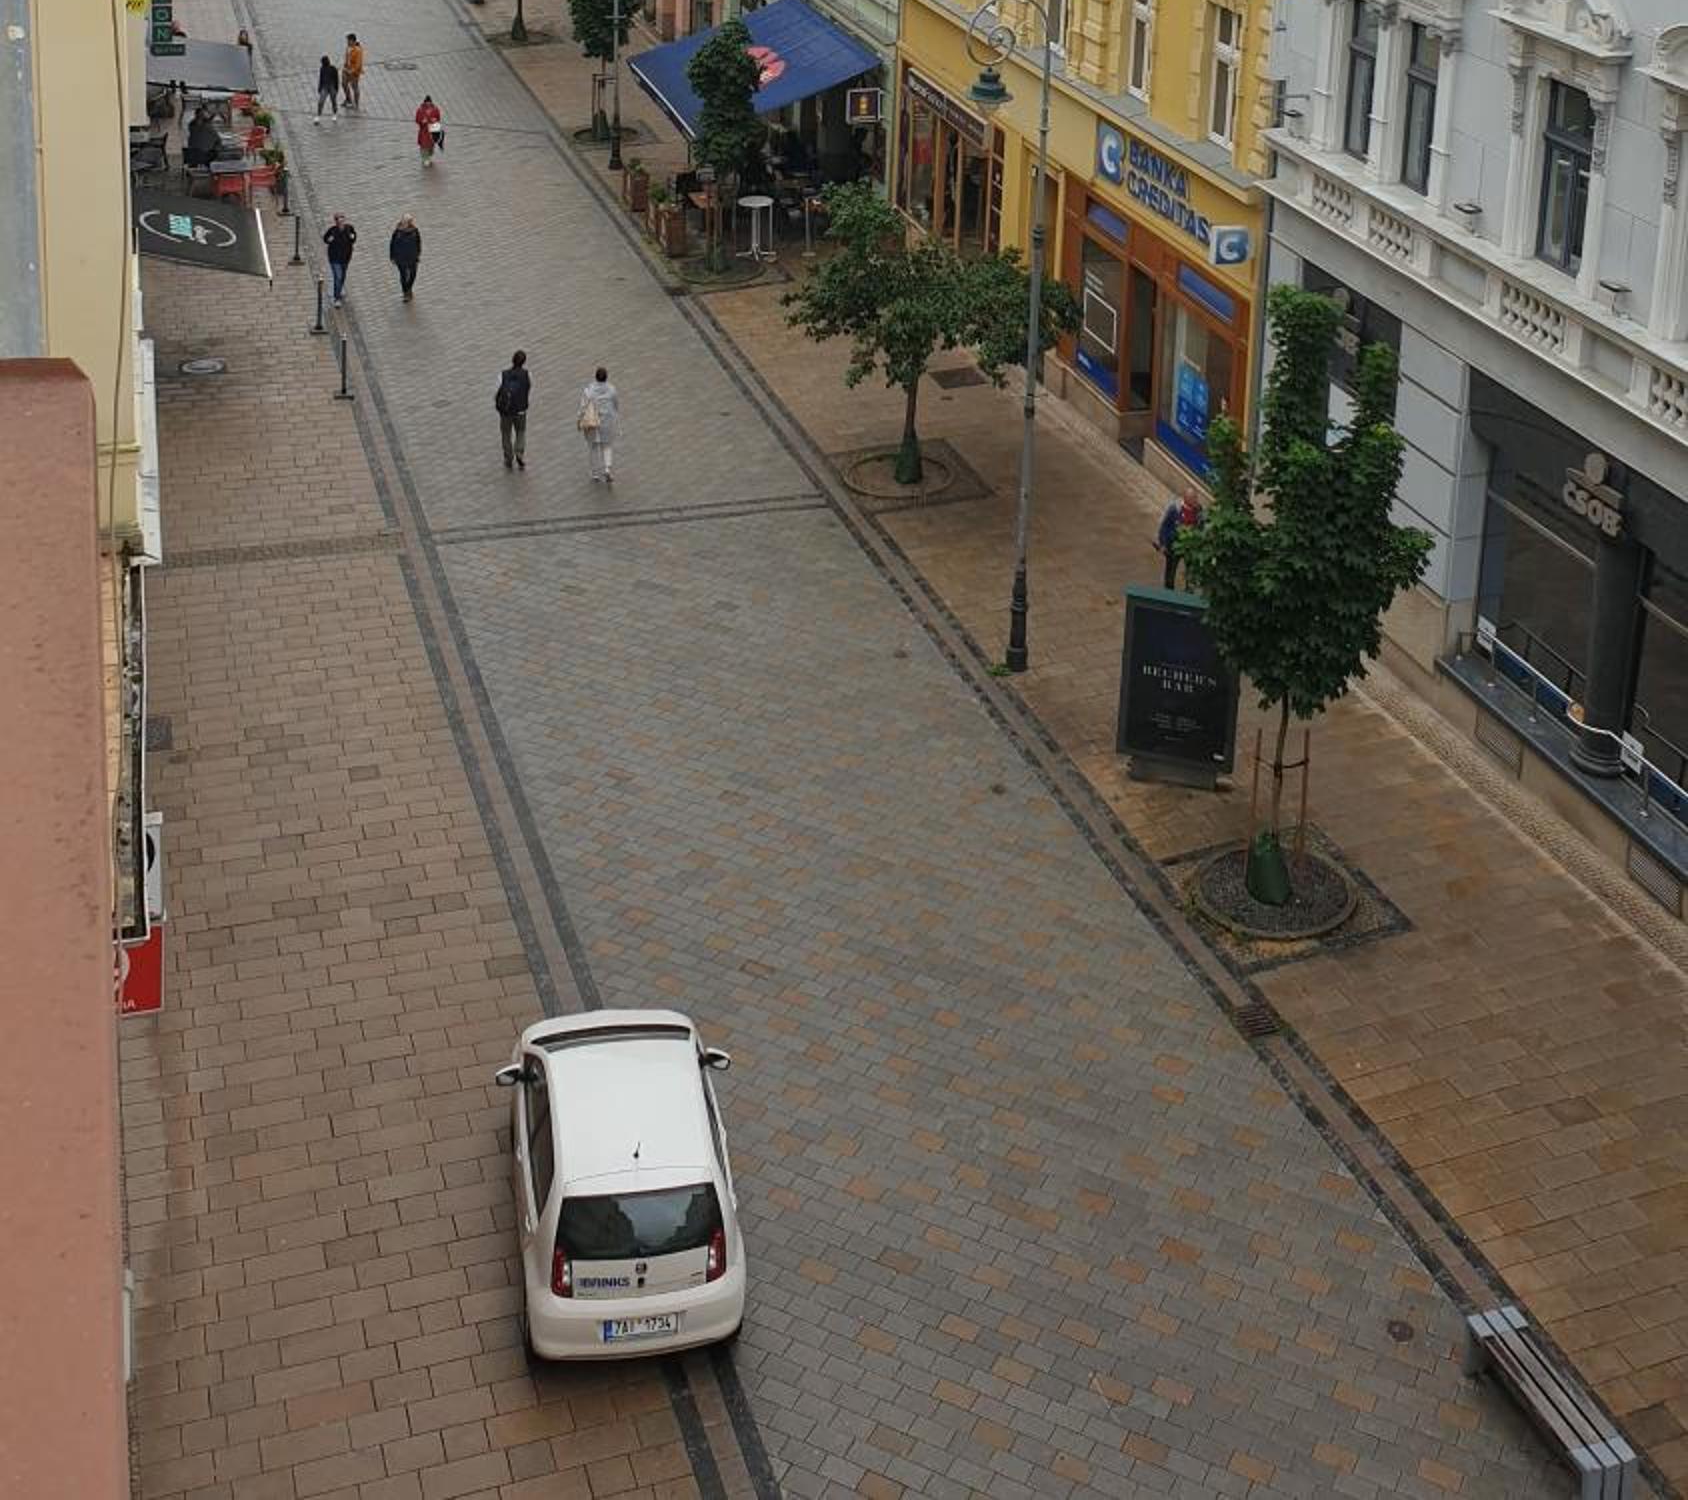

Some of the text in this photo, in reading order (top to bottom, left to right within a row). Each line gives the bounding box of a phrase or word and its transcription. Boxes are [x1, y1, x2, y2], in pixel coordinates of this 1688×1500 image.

[1129, 139, 1186, 197] BANKA
[1127, 169, 1211, 245] CREDITAS
[1562, 479, 1622, 537] ČSOB
